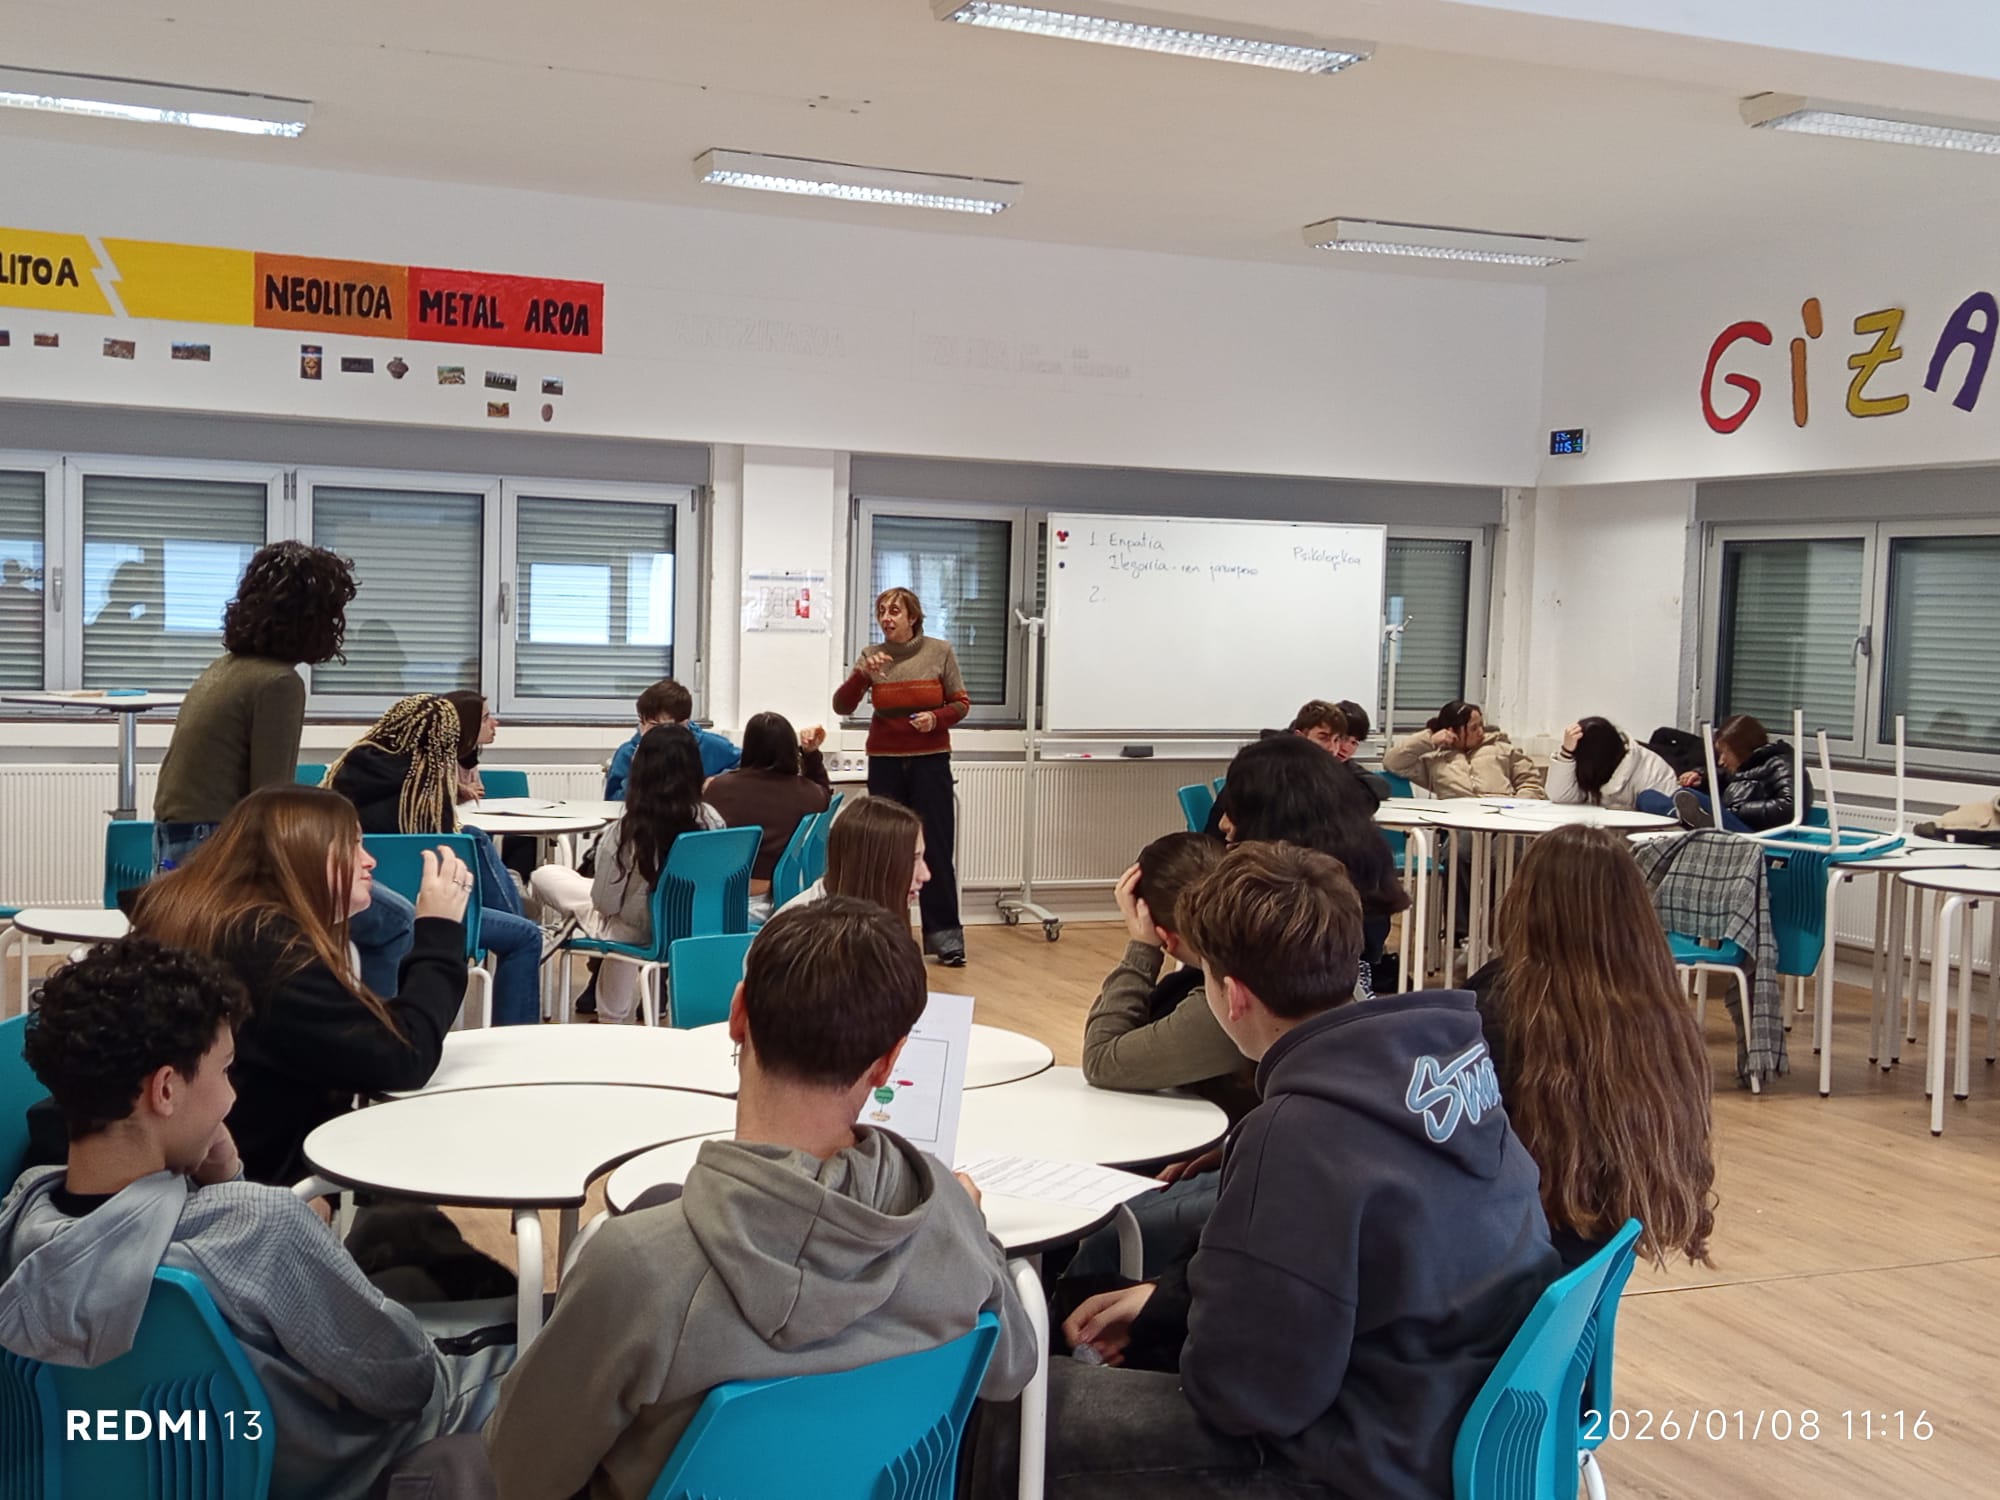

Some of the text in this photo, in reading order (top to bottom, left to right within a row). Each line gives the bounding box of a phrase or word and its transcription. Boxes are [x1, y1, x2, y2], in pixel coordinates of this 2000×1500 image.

[265, 273, 393, 320] NEOLITOA
[418, 289, 590, 337] METAL AROA
